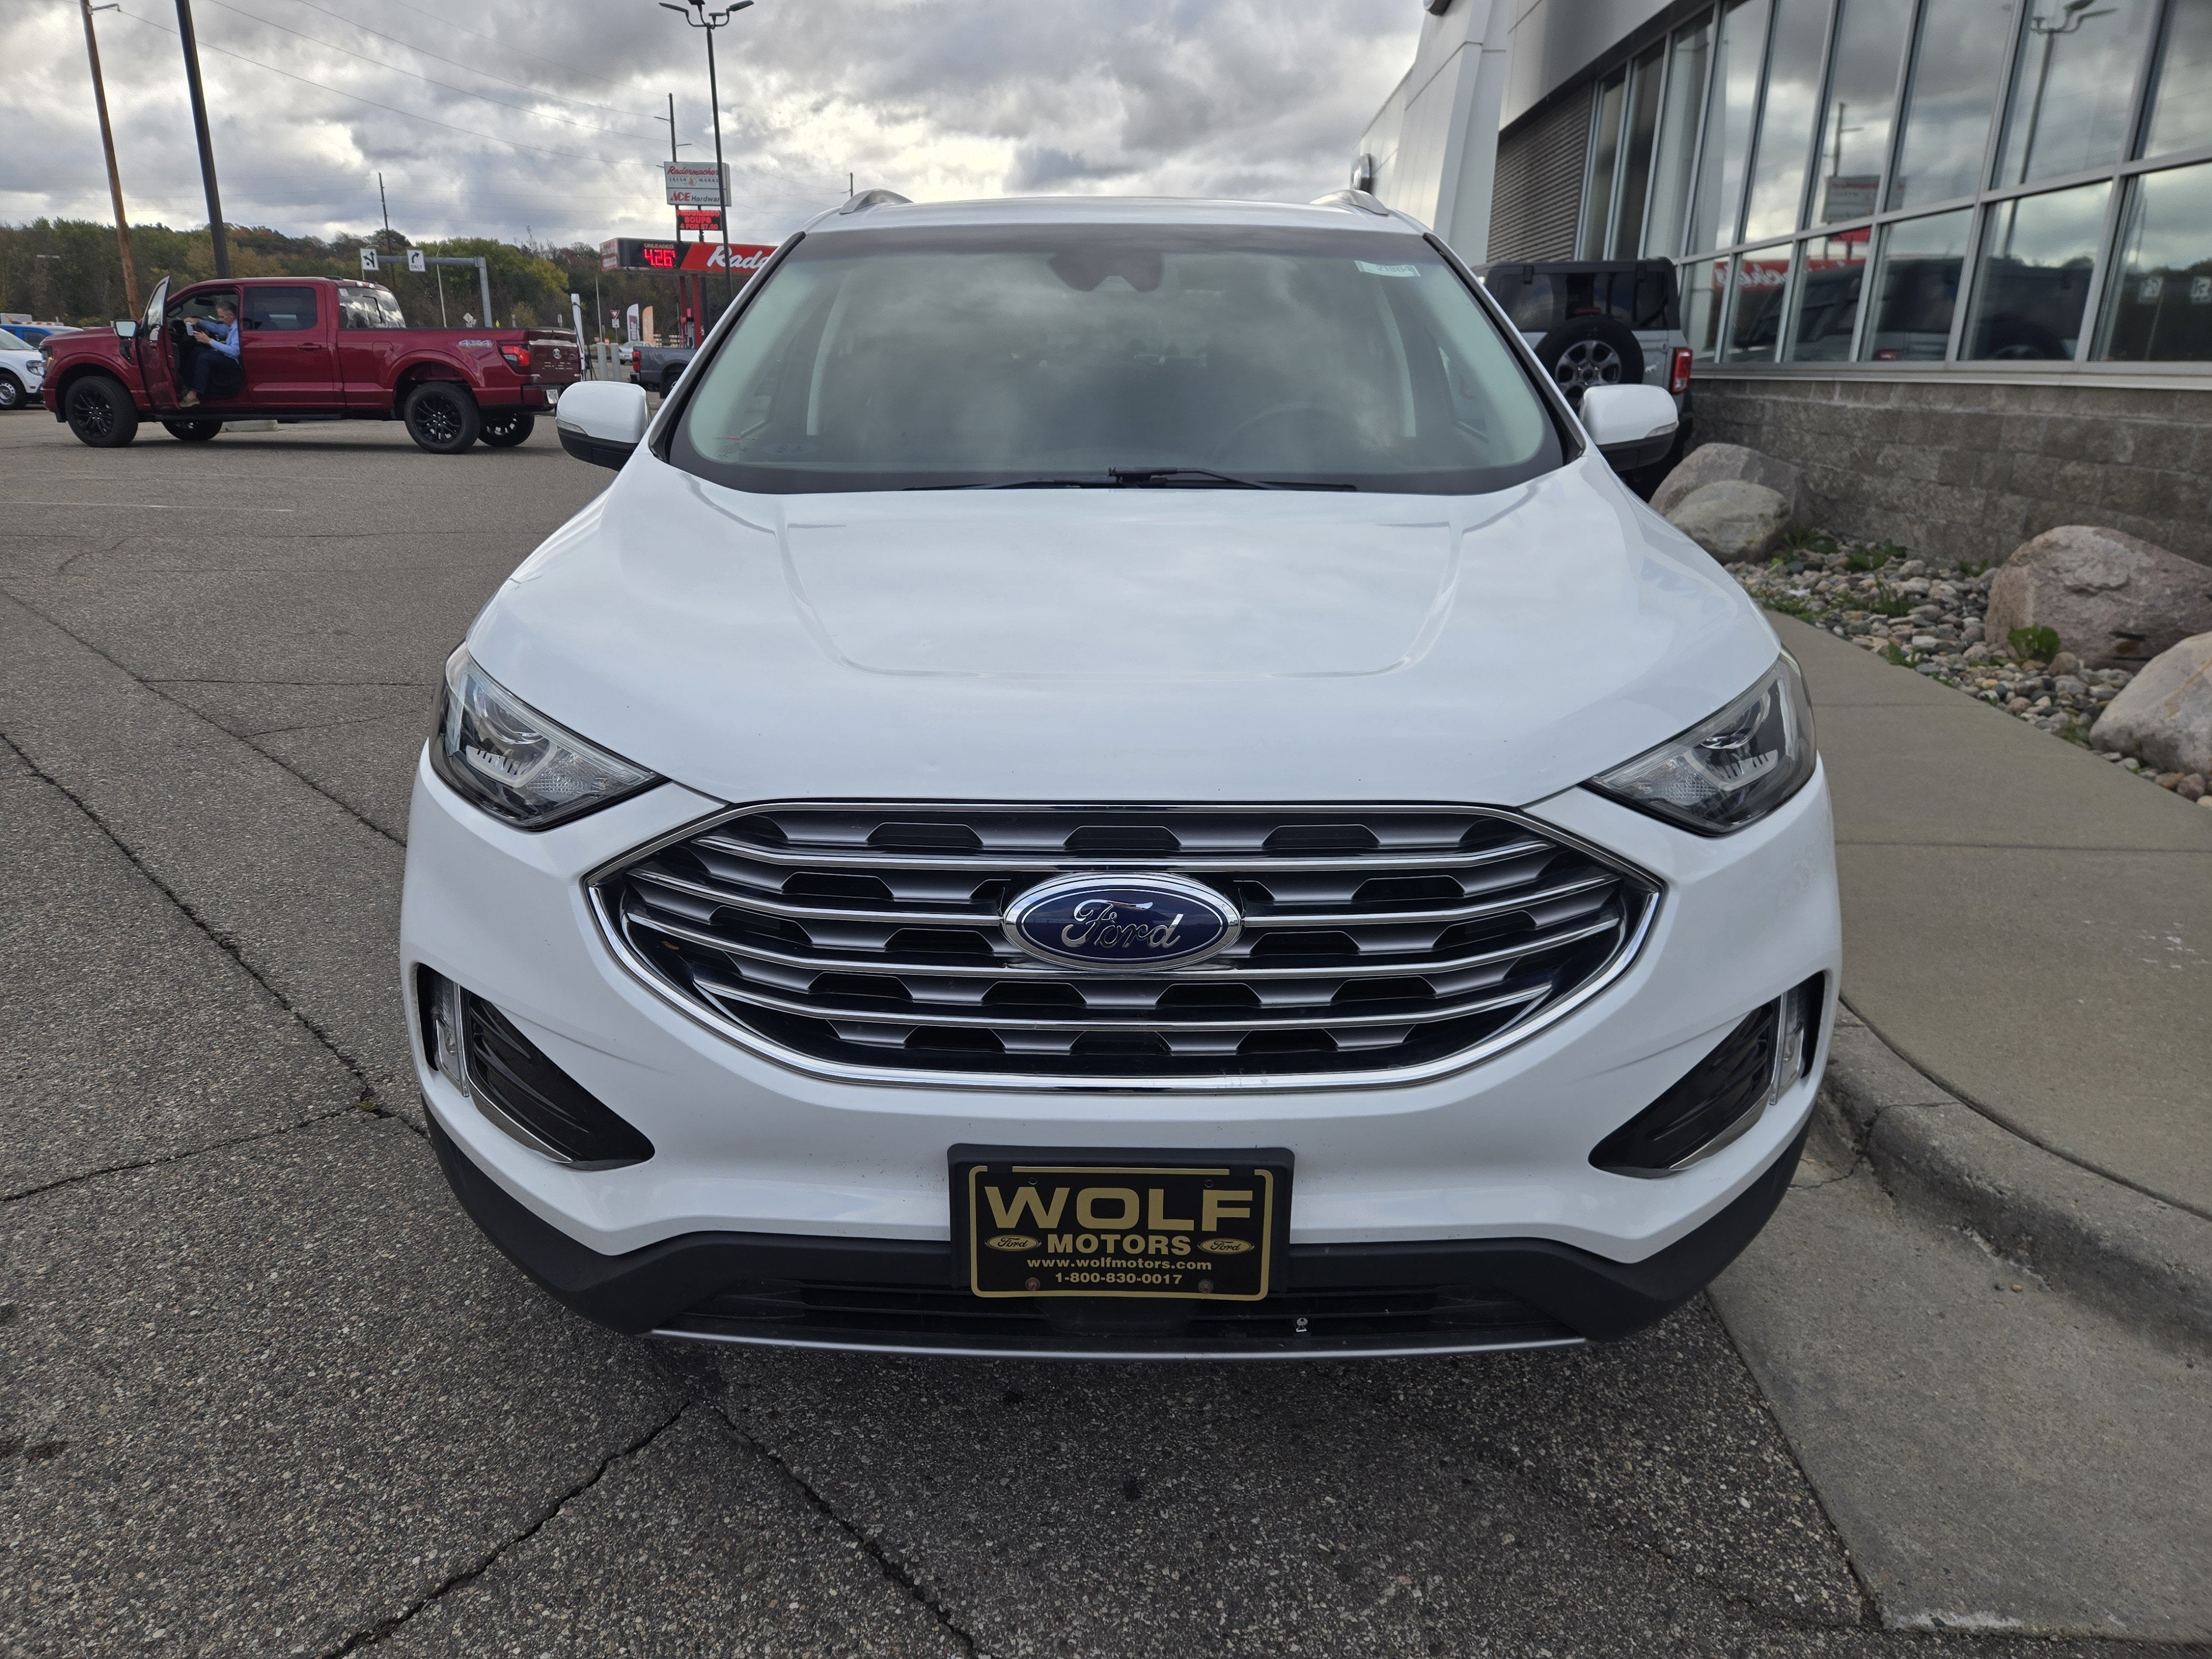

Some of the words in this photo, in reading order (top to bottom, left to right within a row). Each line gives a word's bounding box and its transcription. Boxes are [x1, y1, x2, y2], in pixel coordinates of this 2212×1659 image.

[670, 191, 691, 201] ACE
[1061, 899, 1185, 948] Ford
[984, 1186, 1253, 1232] WOLF
[997, 1238, 1028, 1248] Ford
[1047, 1234, 1191, 1255] MOTORS
[1210, 1240, 1241, 1251] Ford
[1027, 1258, 1212, 1270] www.wolfmotors.com
[1055, 1272, 1182, 1285] 1-800-830-0017
